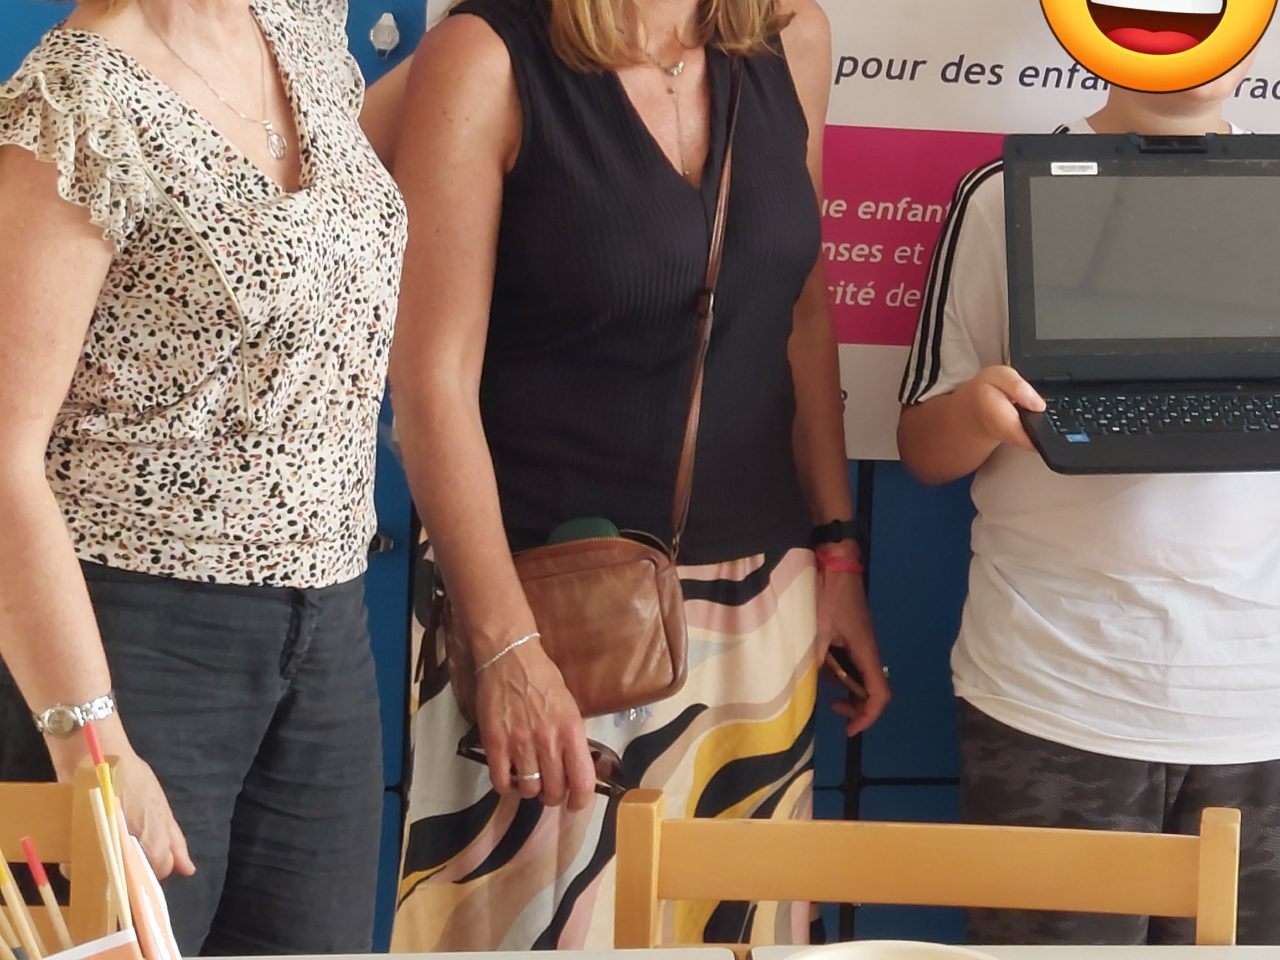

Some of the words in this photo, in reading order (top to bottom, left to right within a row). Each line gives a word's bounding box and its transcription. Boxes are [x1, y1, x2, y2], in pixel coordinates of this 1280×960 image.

[834, 55, 928, 86] pour
[940, 53, 1005, 86] des
[894, 243, 925, 265] et
[885, 282, 922, 308] de
